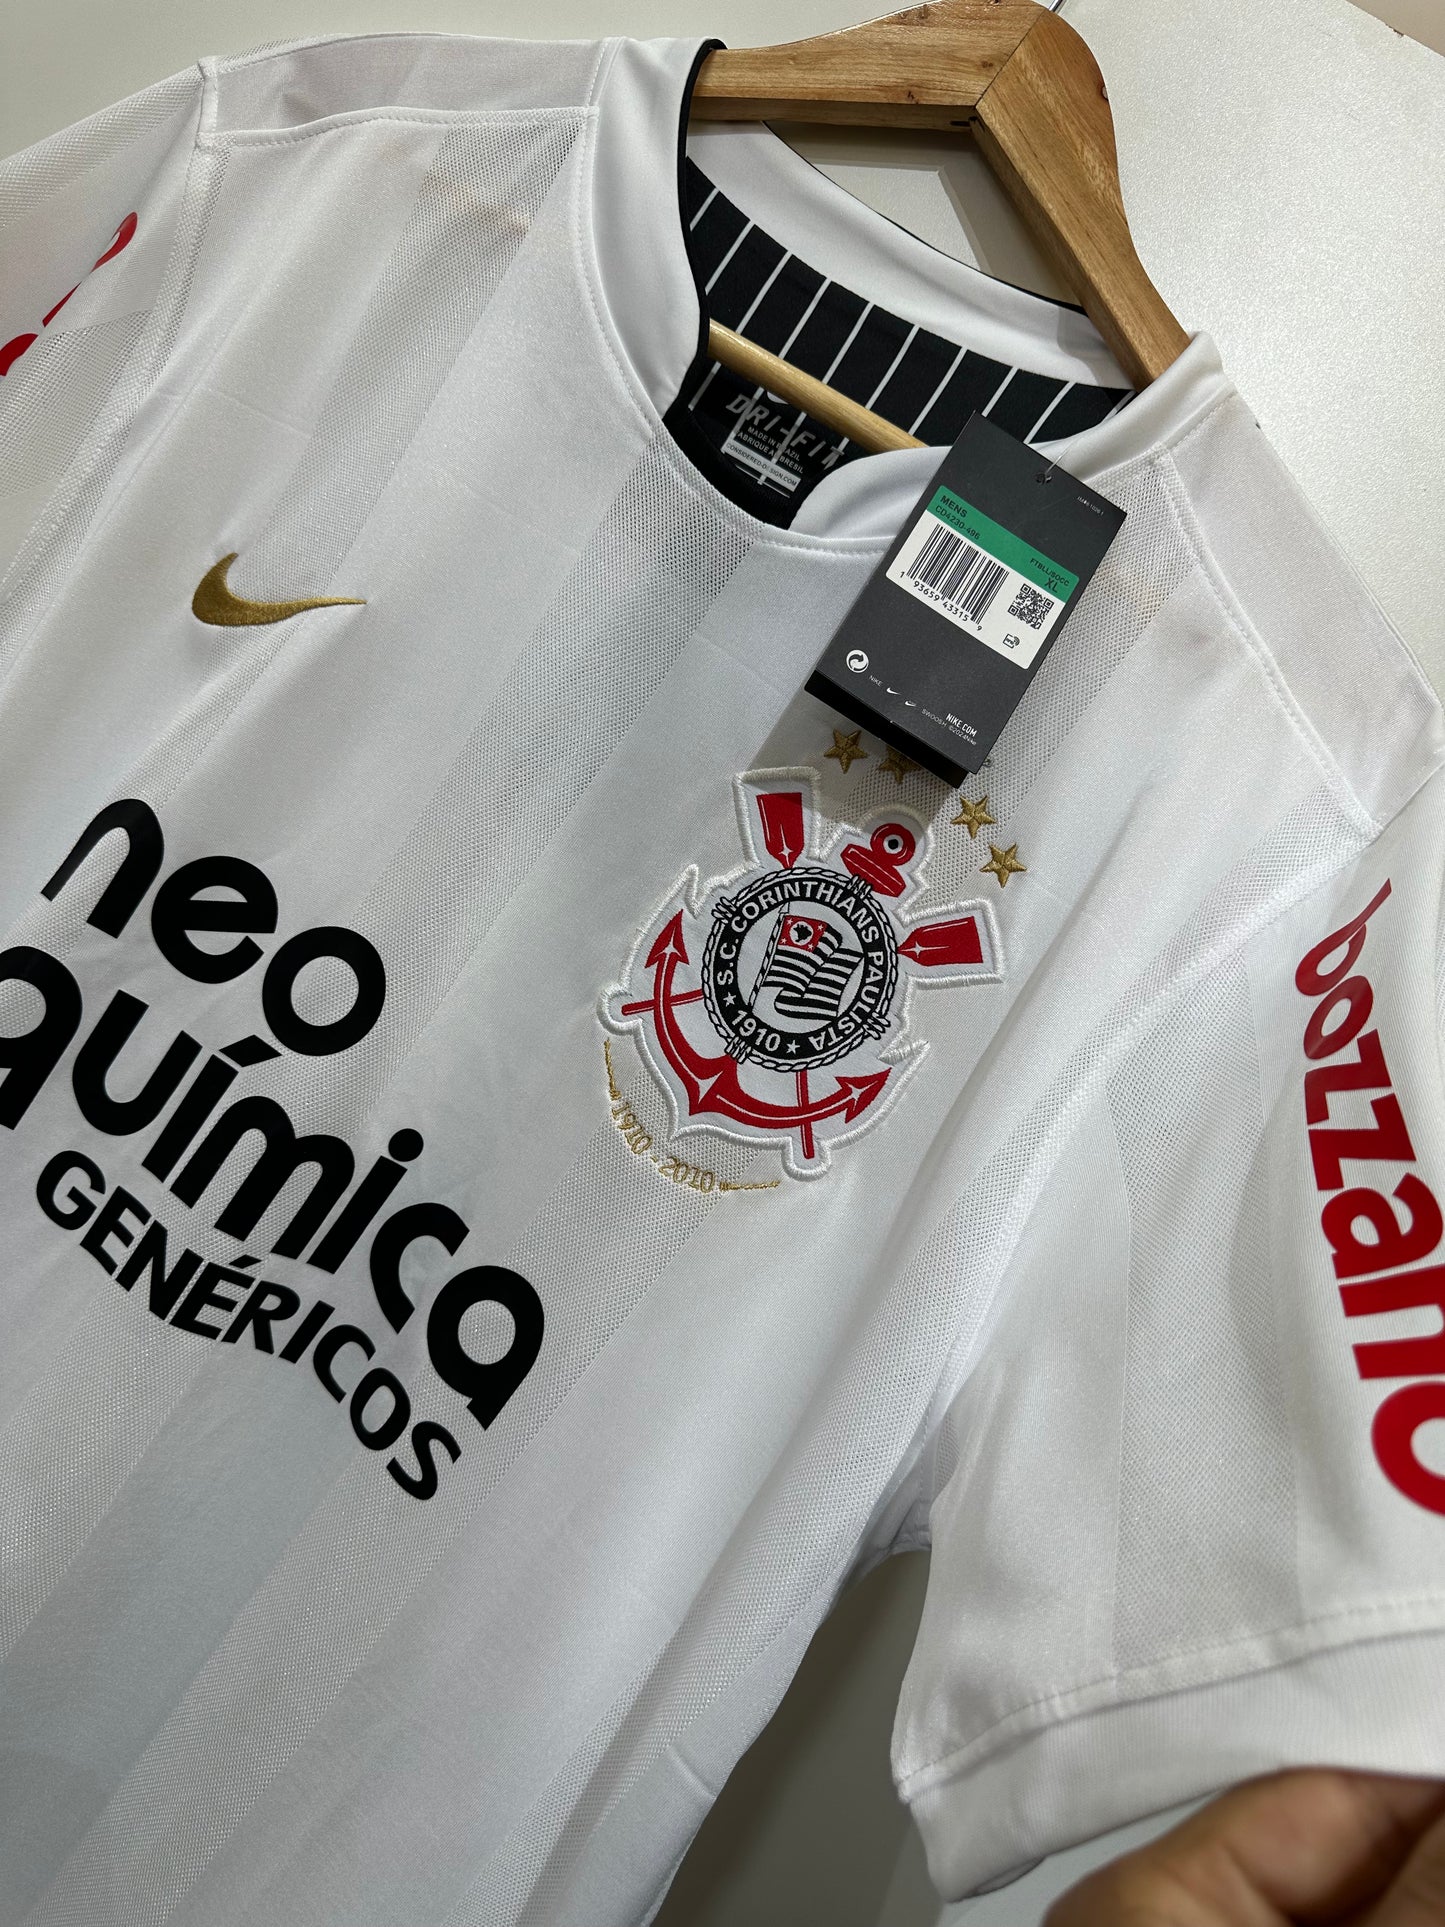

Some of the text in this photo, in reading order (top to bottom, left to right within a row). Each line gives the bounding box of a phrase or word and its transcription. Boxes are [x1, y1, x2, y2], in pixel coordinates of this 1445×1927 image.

[736, 429, 770, 454] ABRIQUE
[747, 426, 801, 461] MADE IN BAZIL
[935, 504, 981, 540] CD4230-496
[940, 494, 969, 519] MENS
[1030, 556, 1070, 588] FTBLL/SOCC
[1045, 576, 1059, 593] XL
[913, 580, 940, 602] 93659
[942, 597, 970, 623] 43315
[976, 623, 983, 633] 9
[868, 673, 885, 688] NIKE
[946, 712, 978, 738] NIKE.COM
[40, 798, 387, 1057] neo
[716, 878, 887, 1053] S.C. CORINTHIANS PAULISTA
[728, 1007, 782, 1053] 1910
[610, 1099, 655, 1157] 1910
[662, 1154, 716, 1194] 2010
[0, 944, 546, 1432] química
[1294, 877, 1445, 1518] bozzano
[35, 1150, 463, 1501] GENÉRICOS
